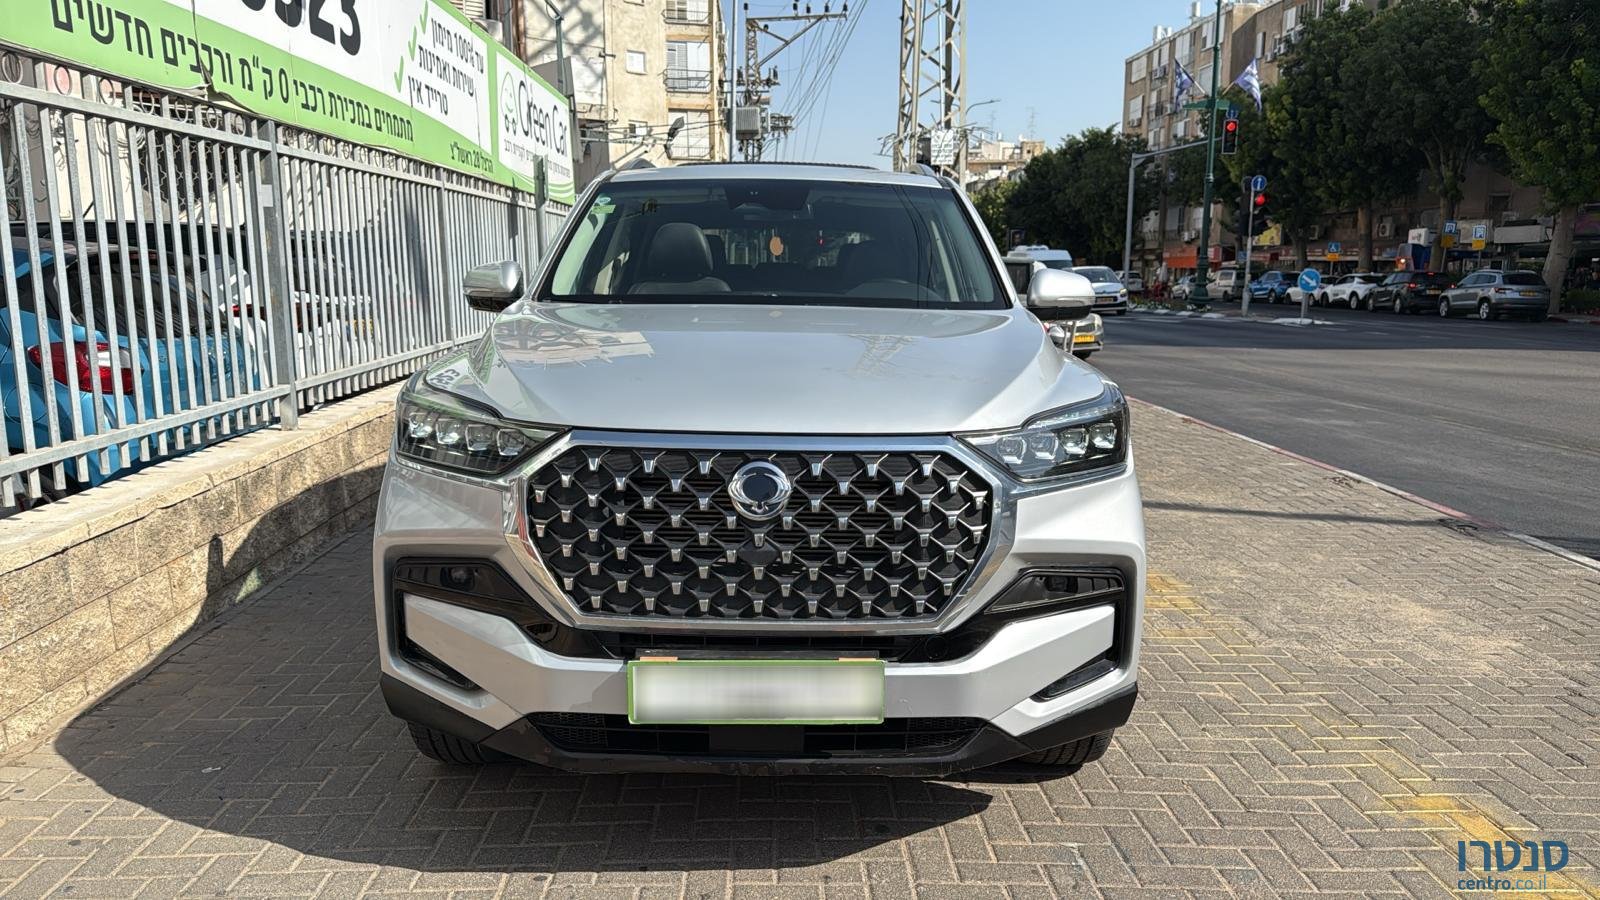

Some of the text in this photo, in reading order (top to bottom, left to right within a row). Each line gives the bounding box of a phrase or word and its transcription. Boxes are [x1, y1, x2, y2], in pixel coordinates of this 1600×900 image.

[50, 0, 154, 59] חדשים
[430, 17, 484, 74] עד 100% מימון
[160, 27, 234, 85] ורכבים
[418, 44, 474, 97] שירות ואמינות
[278, 67, 289, 104] 0
[293, 78, 326, 116] רכבי
[407, 75, 448, 116] טרייד אין
[328, 91, 372, 129] במכירת
[375, 108, 413, 142] מתמחים
[518, 80, 568, 157] Green Car
